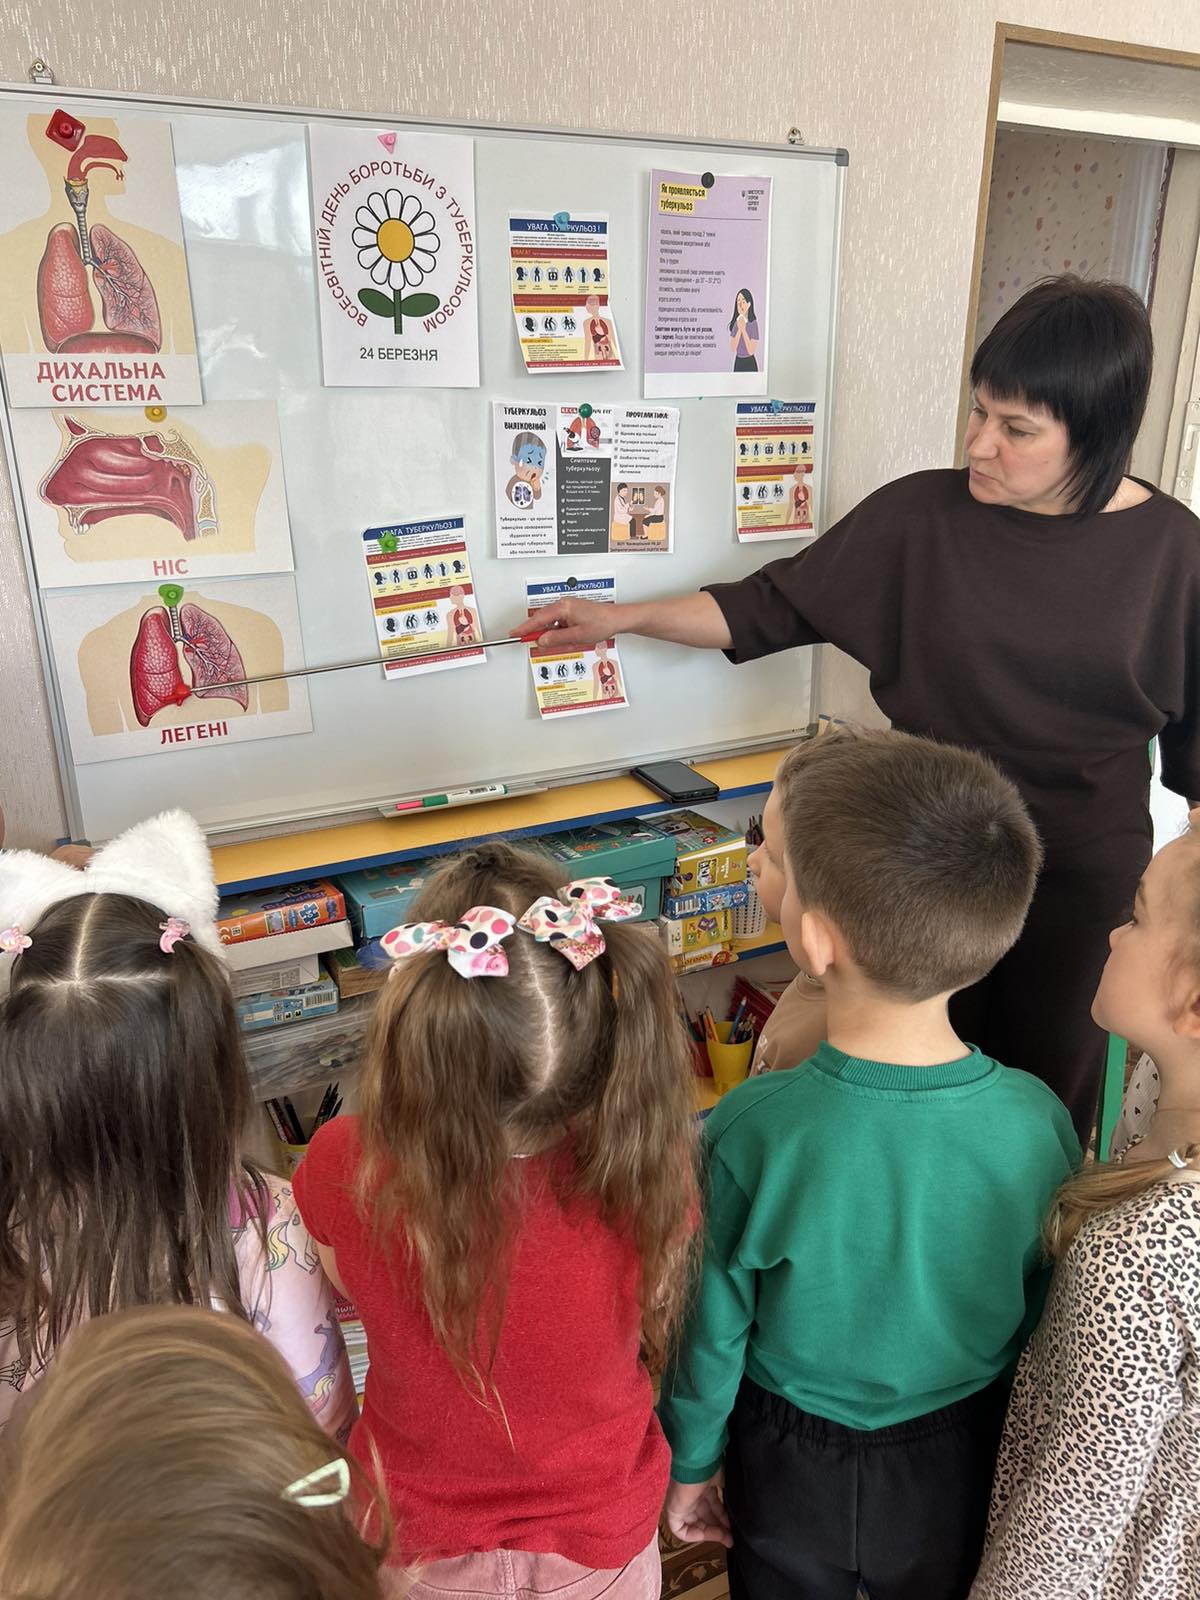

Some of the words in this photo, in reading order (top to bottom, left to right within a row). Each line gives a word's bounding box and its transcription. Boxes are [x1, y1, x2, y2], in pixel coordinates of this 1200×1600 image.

[349, 160, 435, 190] БОРОТЬБИ
[435, 186, 447, 200] З
[321, 183, 350, 227] ДЕНЬ
[660, 198, 694, 212] туберкульоз
[526, 223, 549, 231] УВАГА
[552, 224, 597, 232] ТУРКУЛЬОЗ
[423, 197, 474, 333] ТУБЕРКУЛЬОЗОМ
[316, 228, 368, 328] ВСЕСВІТНІЙ
[360, 348, 374, 360] 24
[378, 348, 438, 361] БЕРЕЗНЯ
[36, 362, 166, 383] ДИХАЛЬНА
[52, 384, 162, 402] СИСТЕМА
[504, 406, 547, 416] ТУБЕРКУЛЬОЗ
[504, 422, 546, 430] ВИЛІКОВНИЙ
[406, 522, 452, 534] ТУБЕРКУЛЬОЗ
[152, 558, 190, 576] НІС
[160, 721, 228, 745] ЛЕГЕНІ
